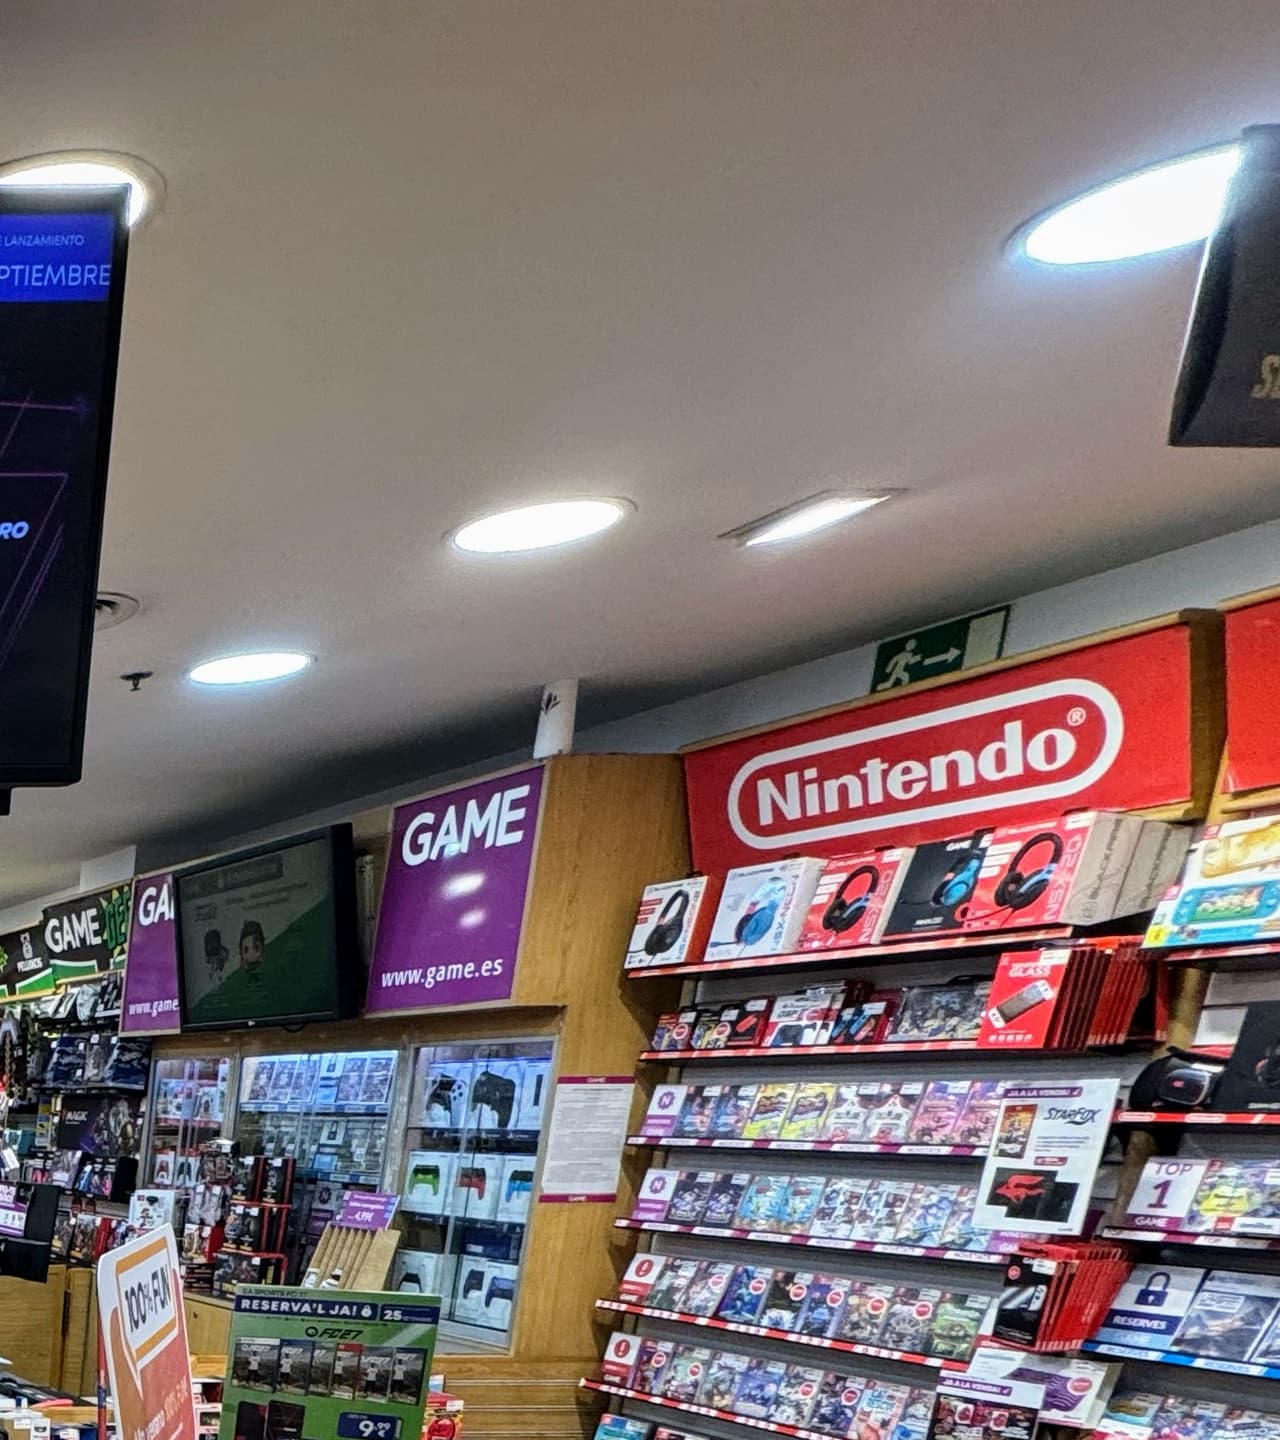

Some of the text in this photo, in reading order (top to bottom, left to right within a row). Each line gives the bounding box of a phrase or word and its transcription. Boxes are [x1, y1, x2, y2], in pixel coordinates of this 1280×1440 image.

[4, 235, 84, 247] LANZAMIENTO
[402, 784, 531, 867] GAME
[139, 883, 175, 927] GA
[44, 908, 102, 952] GAME
[381, 956, 504, 989] www.game.es
[1009, 964, 1054, 978] GLASS
[1154, 1162, 1193, 1176] TOP
[1147, 1179, 1174, 1210] 1
[1135, 1217, 1170, 1228] GAME
[240, 1299, 357, 1317] RESERVA'L JA!
[383, 1310, 402, 1321] 25
[1112, 1315, 1167, 1331] RESERVES
